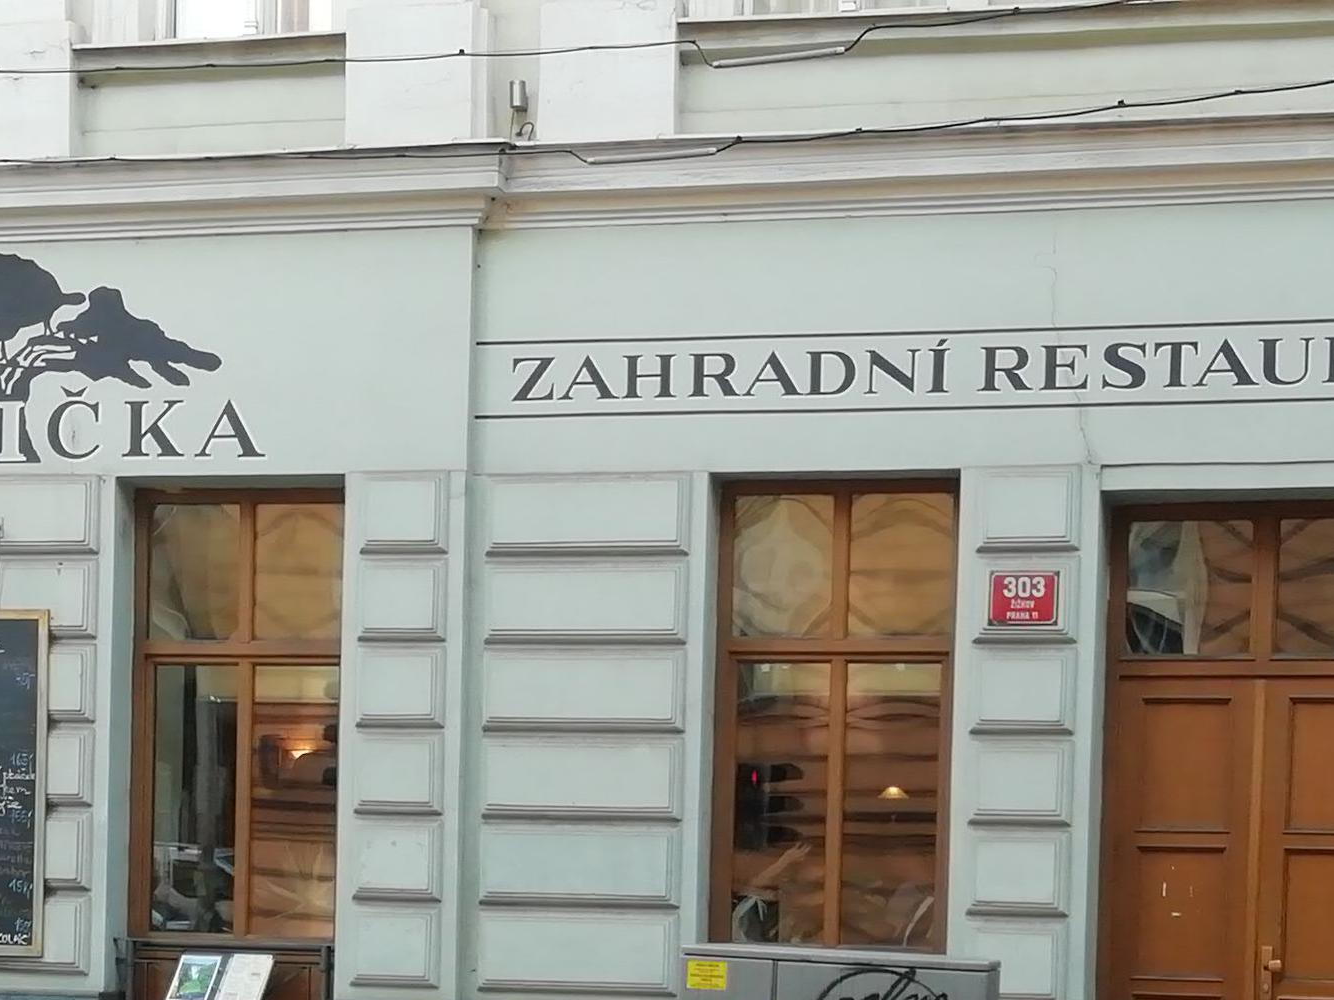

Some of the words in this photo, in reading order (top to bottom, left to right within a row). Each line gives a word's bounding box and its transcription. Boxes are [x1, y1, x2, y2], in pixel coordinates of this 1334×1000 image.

[511, 338, 950, 402] ZAHRADNÍ
[1003, 576, 1045, 598] 303
[1006, 611, 1030, 620] PRAHA
